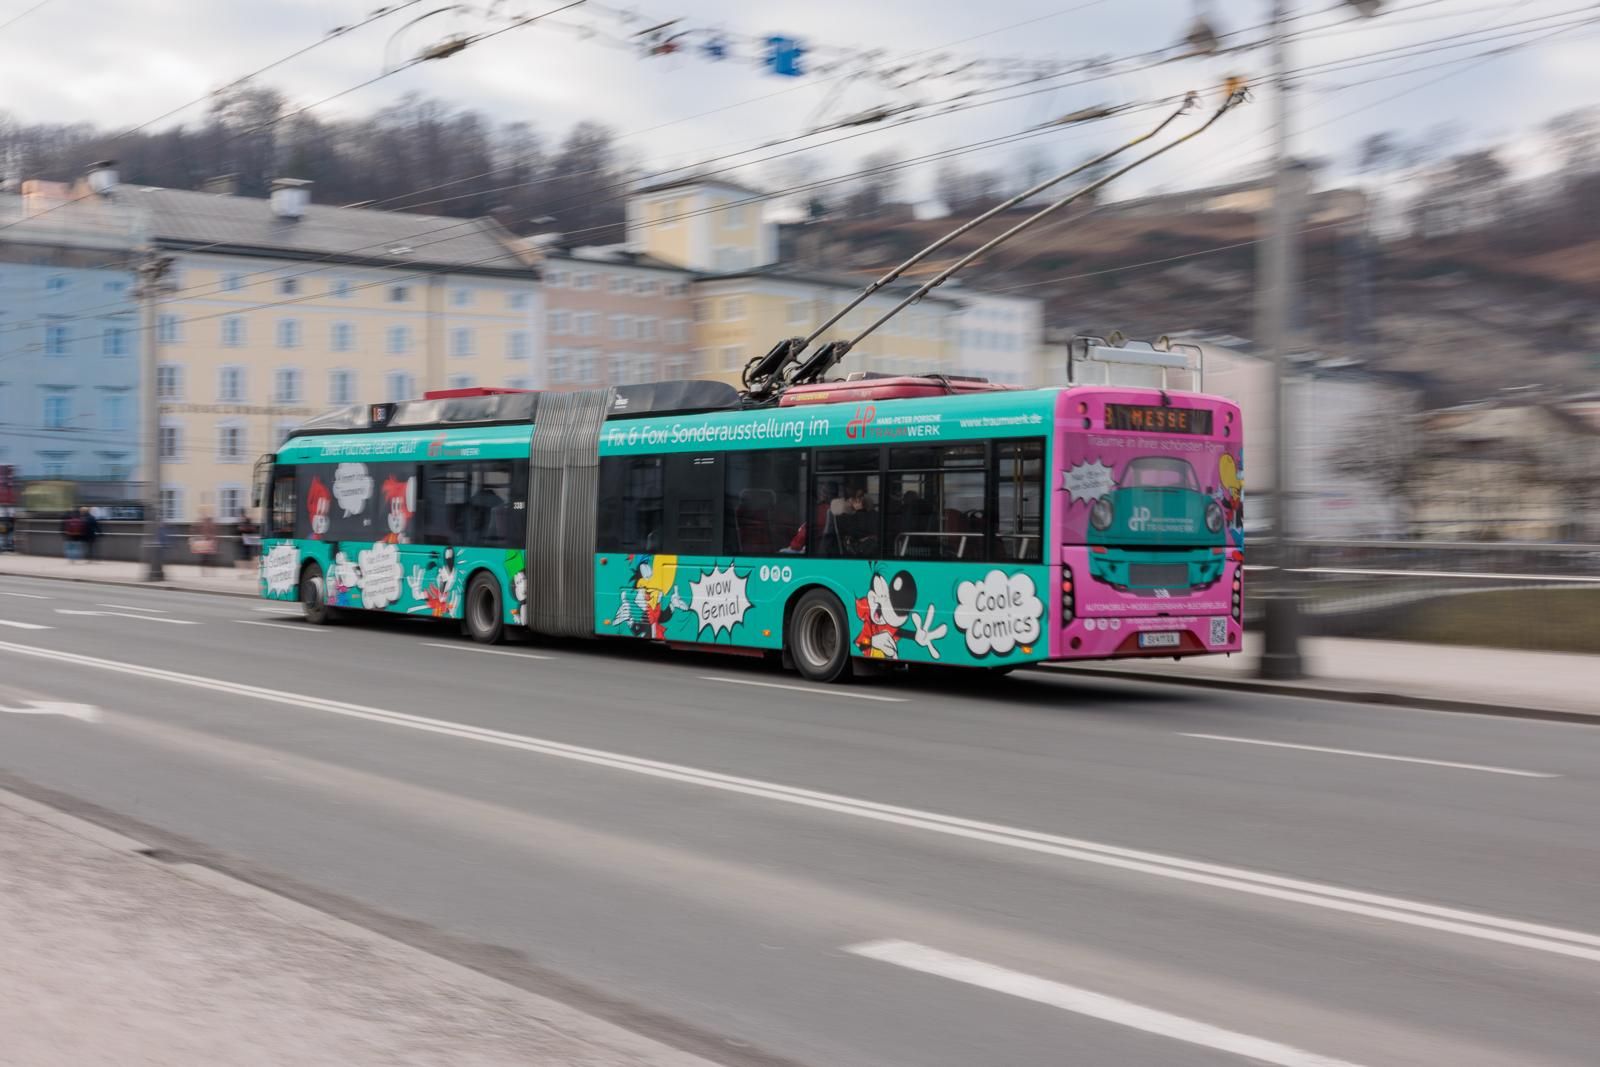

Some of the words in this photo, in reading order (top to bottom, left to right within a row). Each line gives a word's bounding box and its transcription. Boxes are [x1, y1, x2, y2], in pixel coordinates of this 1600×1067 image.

[607, 427, 625, 447] Fix
[627, 426, 638, 447] &
[641, 424, 669, 445] Foxi
[671, 417, 805, 443] Sonderausstellung
[808, 415, 830, 436] im
[1131, 408, 1187, 429] MESSE
[700, 597, 740, 620] Genial
[974, 585, 1024, 612] Coole
[971, 615, 1033, 640] Comics
